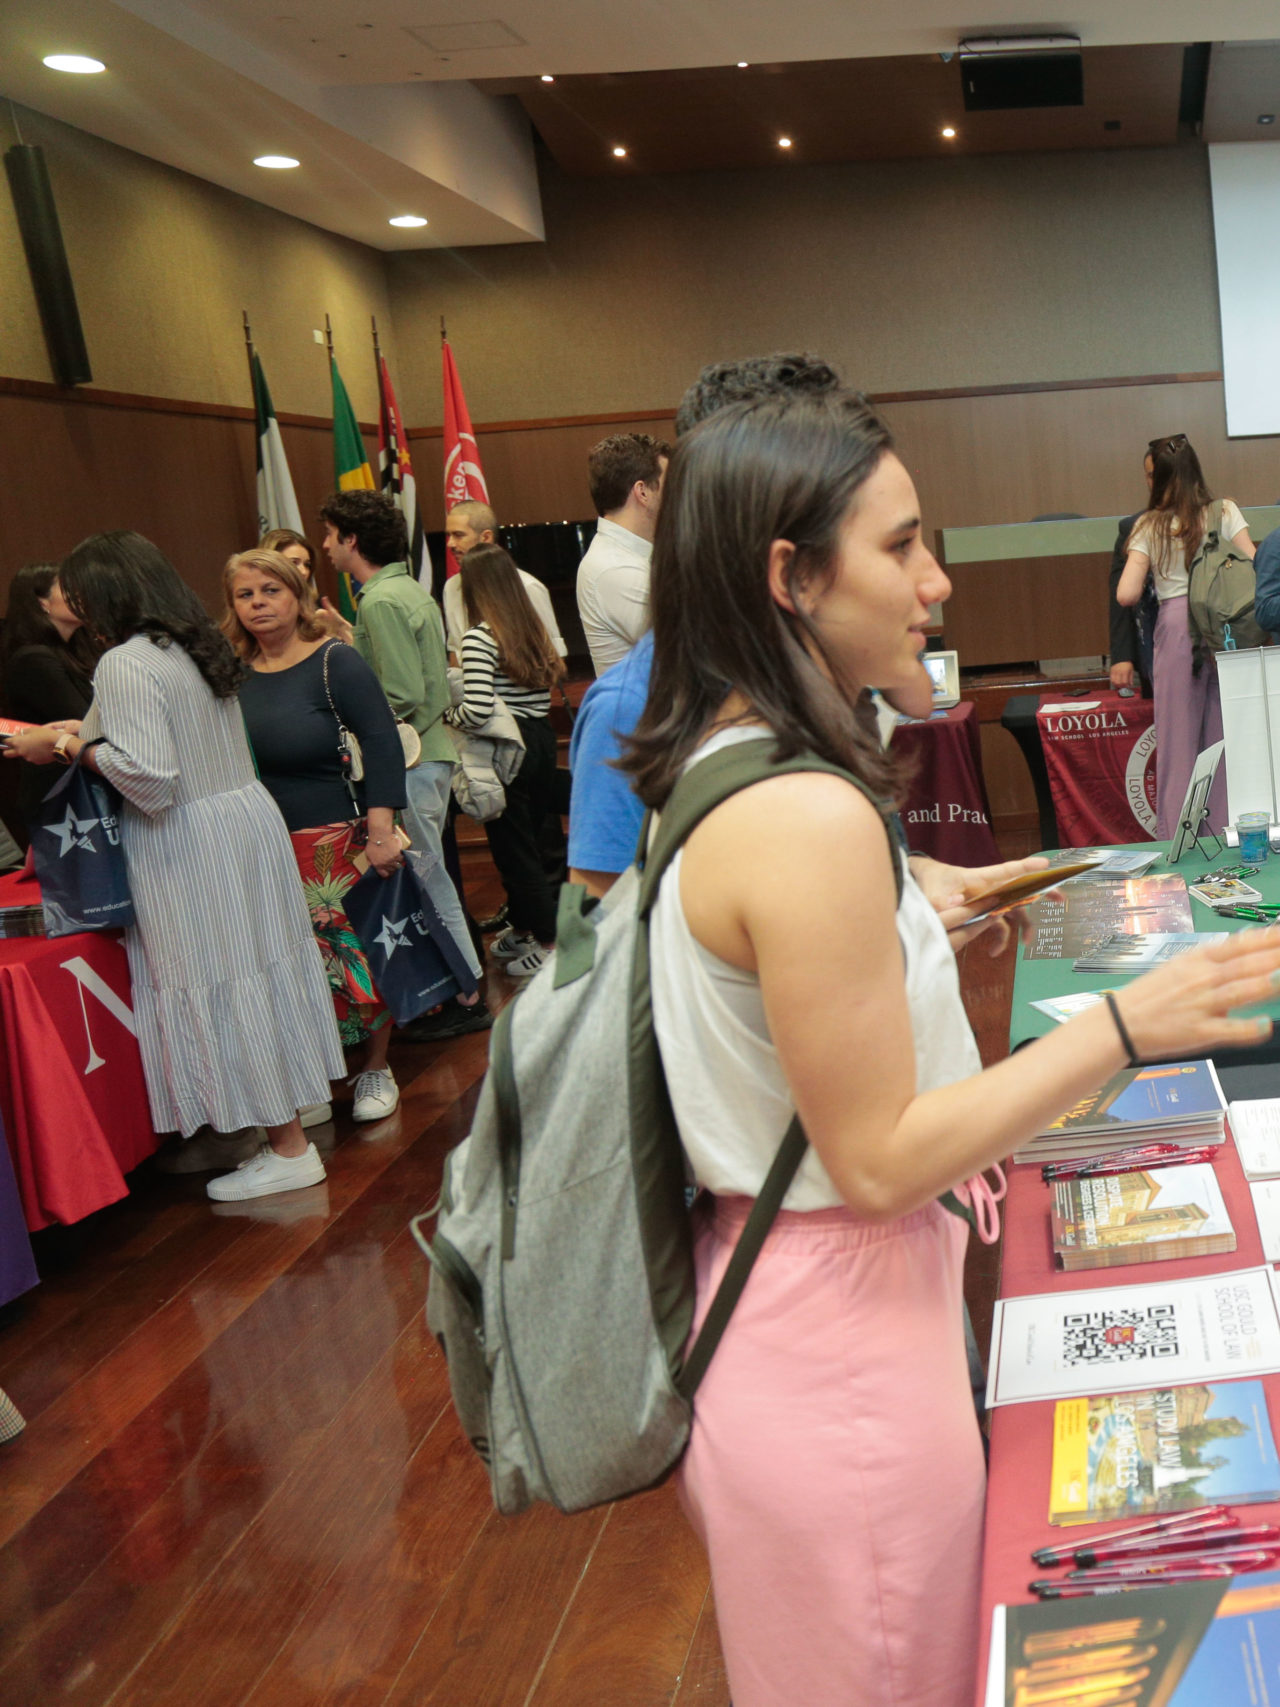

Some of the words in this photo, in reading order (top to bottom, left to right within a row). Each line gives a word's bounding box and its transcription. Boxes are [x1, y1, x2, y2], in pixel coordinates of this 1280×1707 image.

[1045, 711, 1128, 733] LOYOLA
[907, 803, 941, 823] and
[1129, 778, 1152, 824] LOYOLA
[1091, 1177, 1110, 1225] RESOLUTION
[1106, 1176, 1124, 1208] DISPUTE
[1214, 1286, 1235, 1323] SCHOOL
[1236, 1303, 1258, 1336] GOULD
[1221, 1323, 1239, 1338] OF
[1223, 1338, 1243, 1361] LAW
[1112, 1398, 1137, 1424] LOS
[1134, 1395, 1156, 1412] IN
[1154, 1391, 1179, 1435] STUDY
[1117, 1425, 1140, 1489] ANGELES
[1158, 1434, 1182, 1469] LAW
